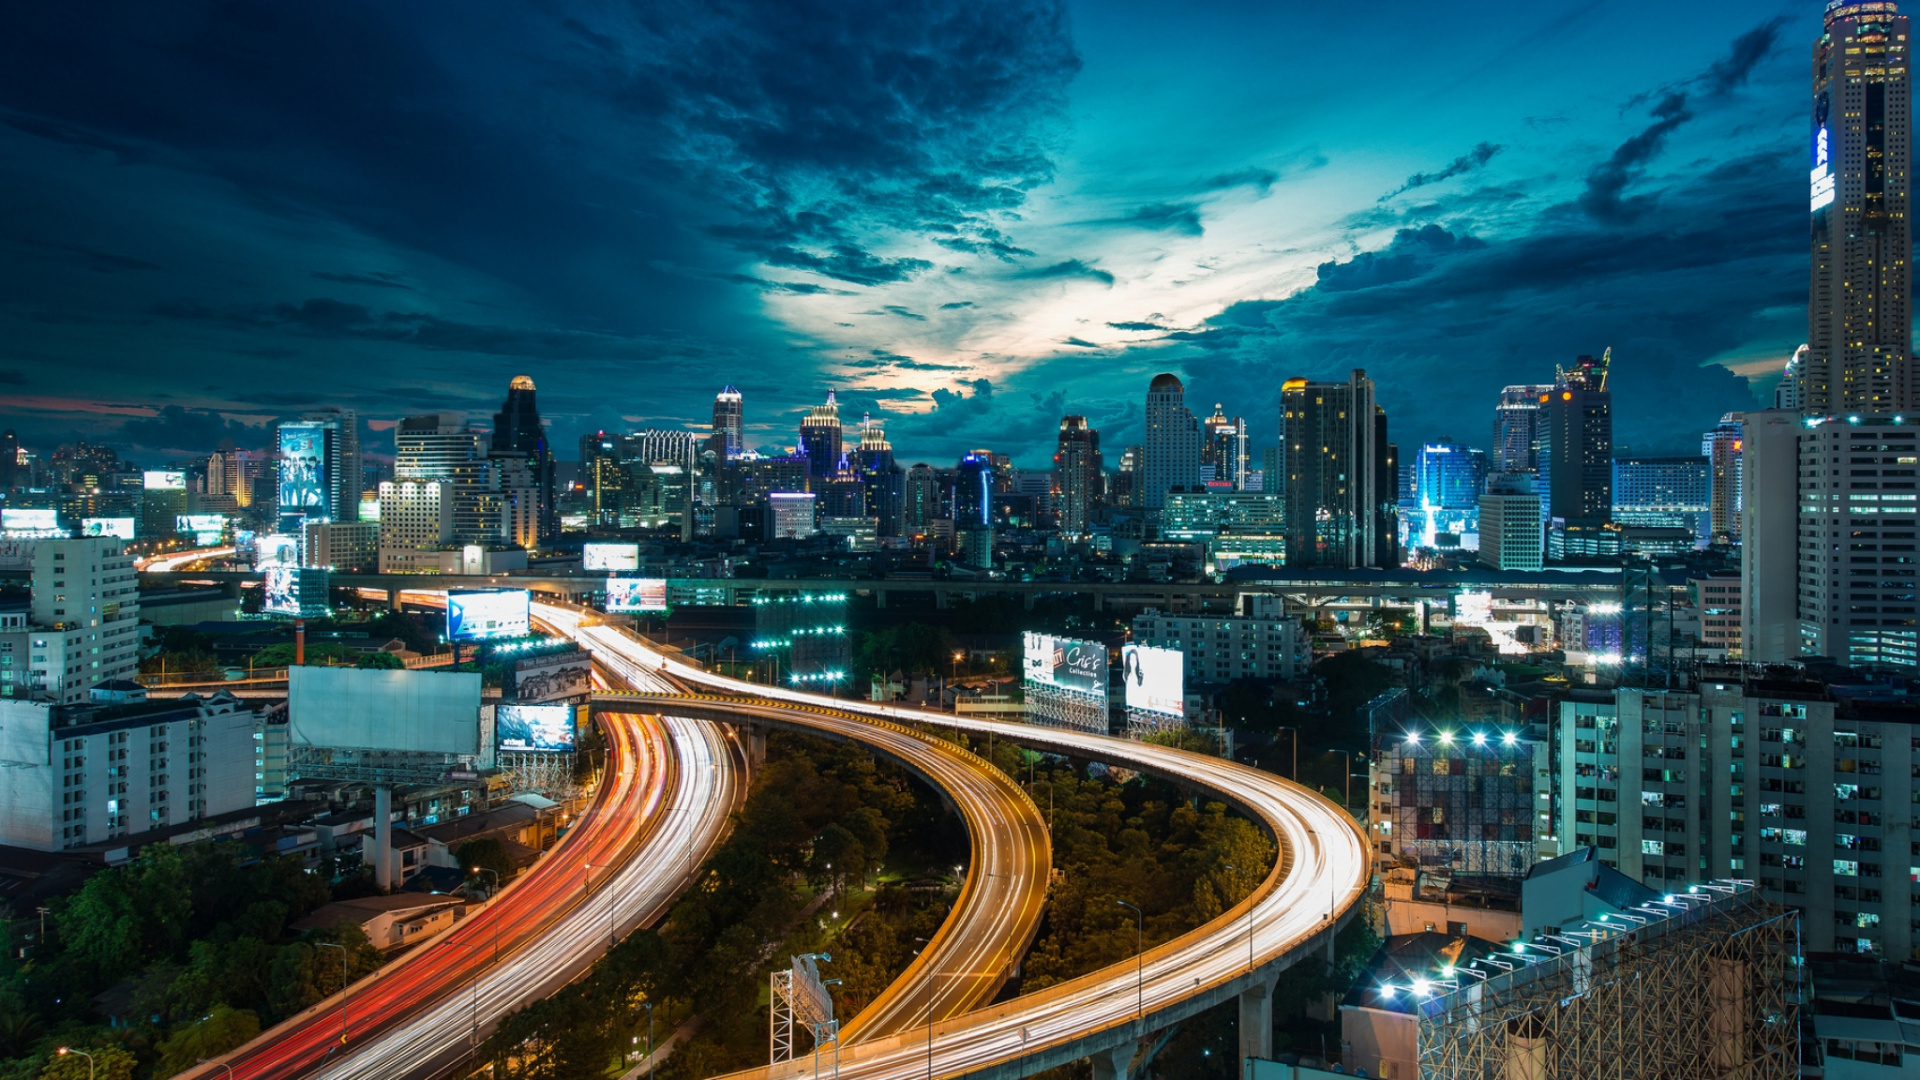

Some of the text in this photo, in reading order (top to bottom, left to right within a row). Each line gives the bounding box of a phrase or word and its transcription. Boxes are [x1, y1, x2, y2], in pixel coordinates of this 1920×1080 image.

[1066, 646, 1101, 670] Cris's
[1069, 667, 1097, 678] Collection
[569, 696, 580, 704] 053
